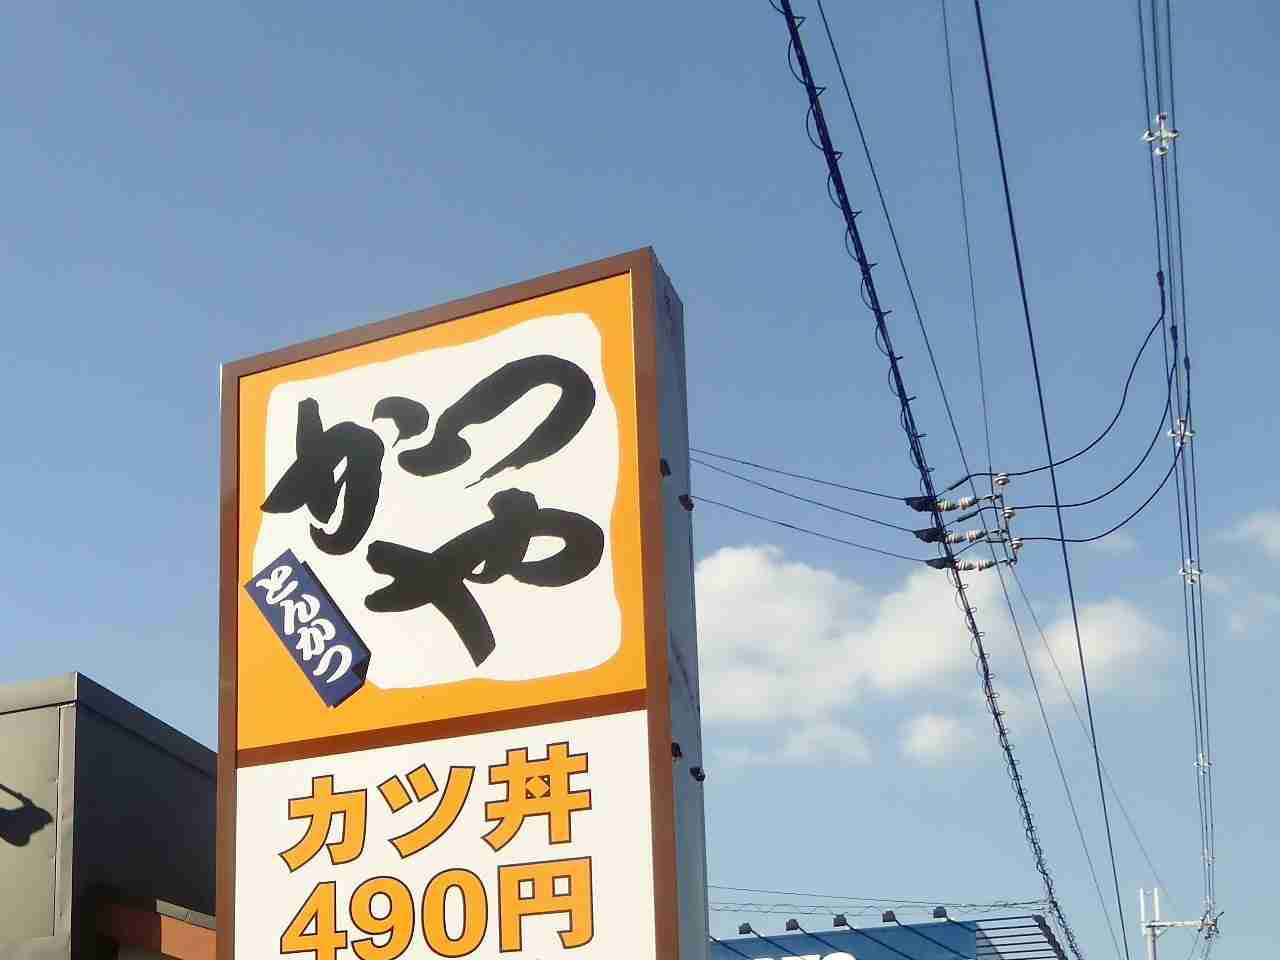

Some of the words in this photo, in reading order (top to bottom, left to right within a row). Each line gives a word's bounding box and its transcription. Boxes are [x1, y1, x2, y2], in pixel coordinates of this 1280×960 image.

[260, 354, 605, 668] かつや
[255, 564, 353, 684] とんかつ
[278, 741, 592, 872] カツ丼
